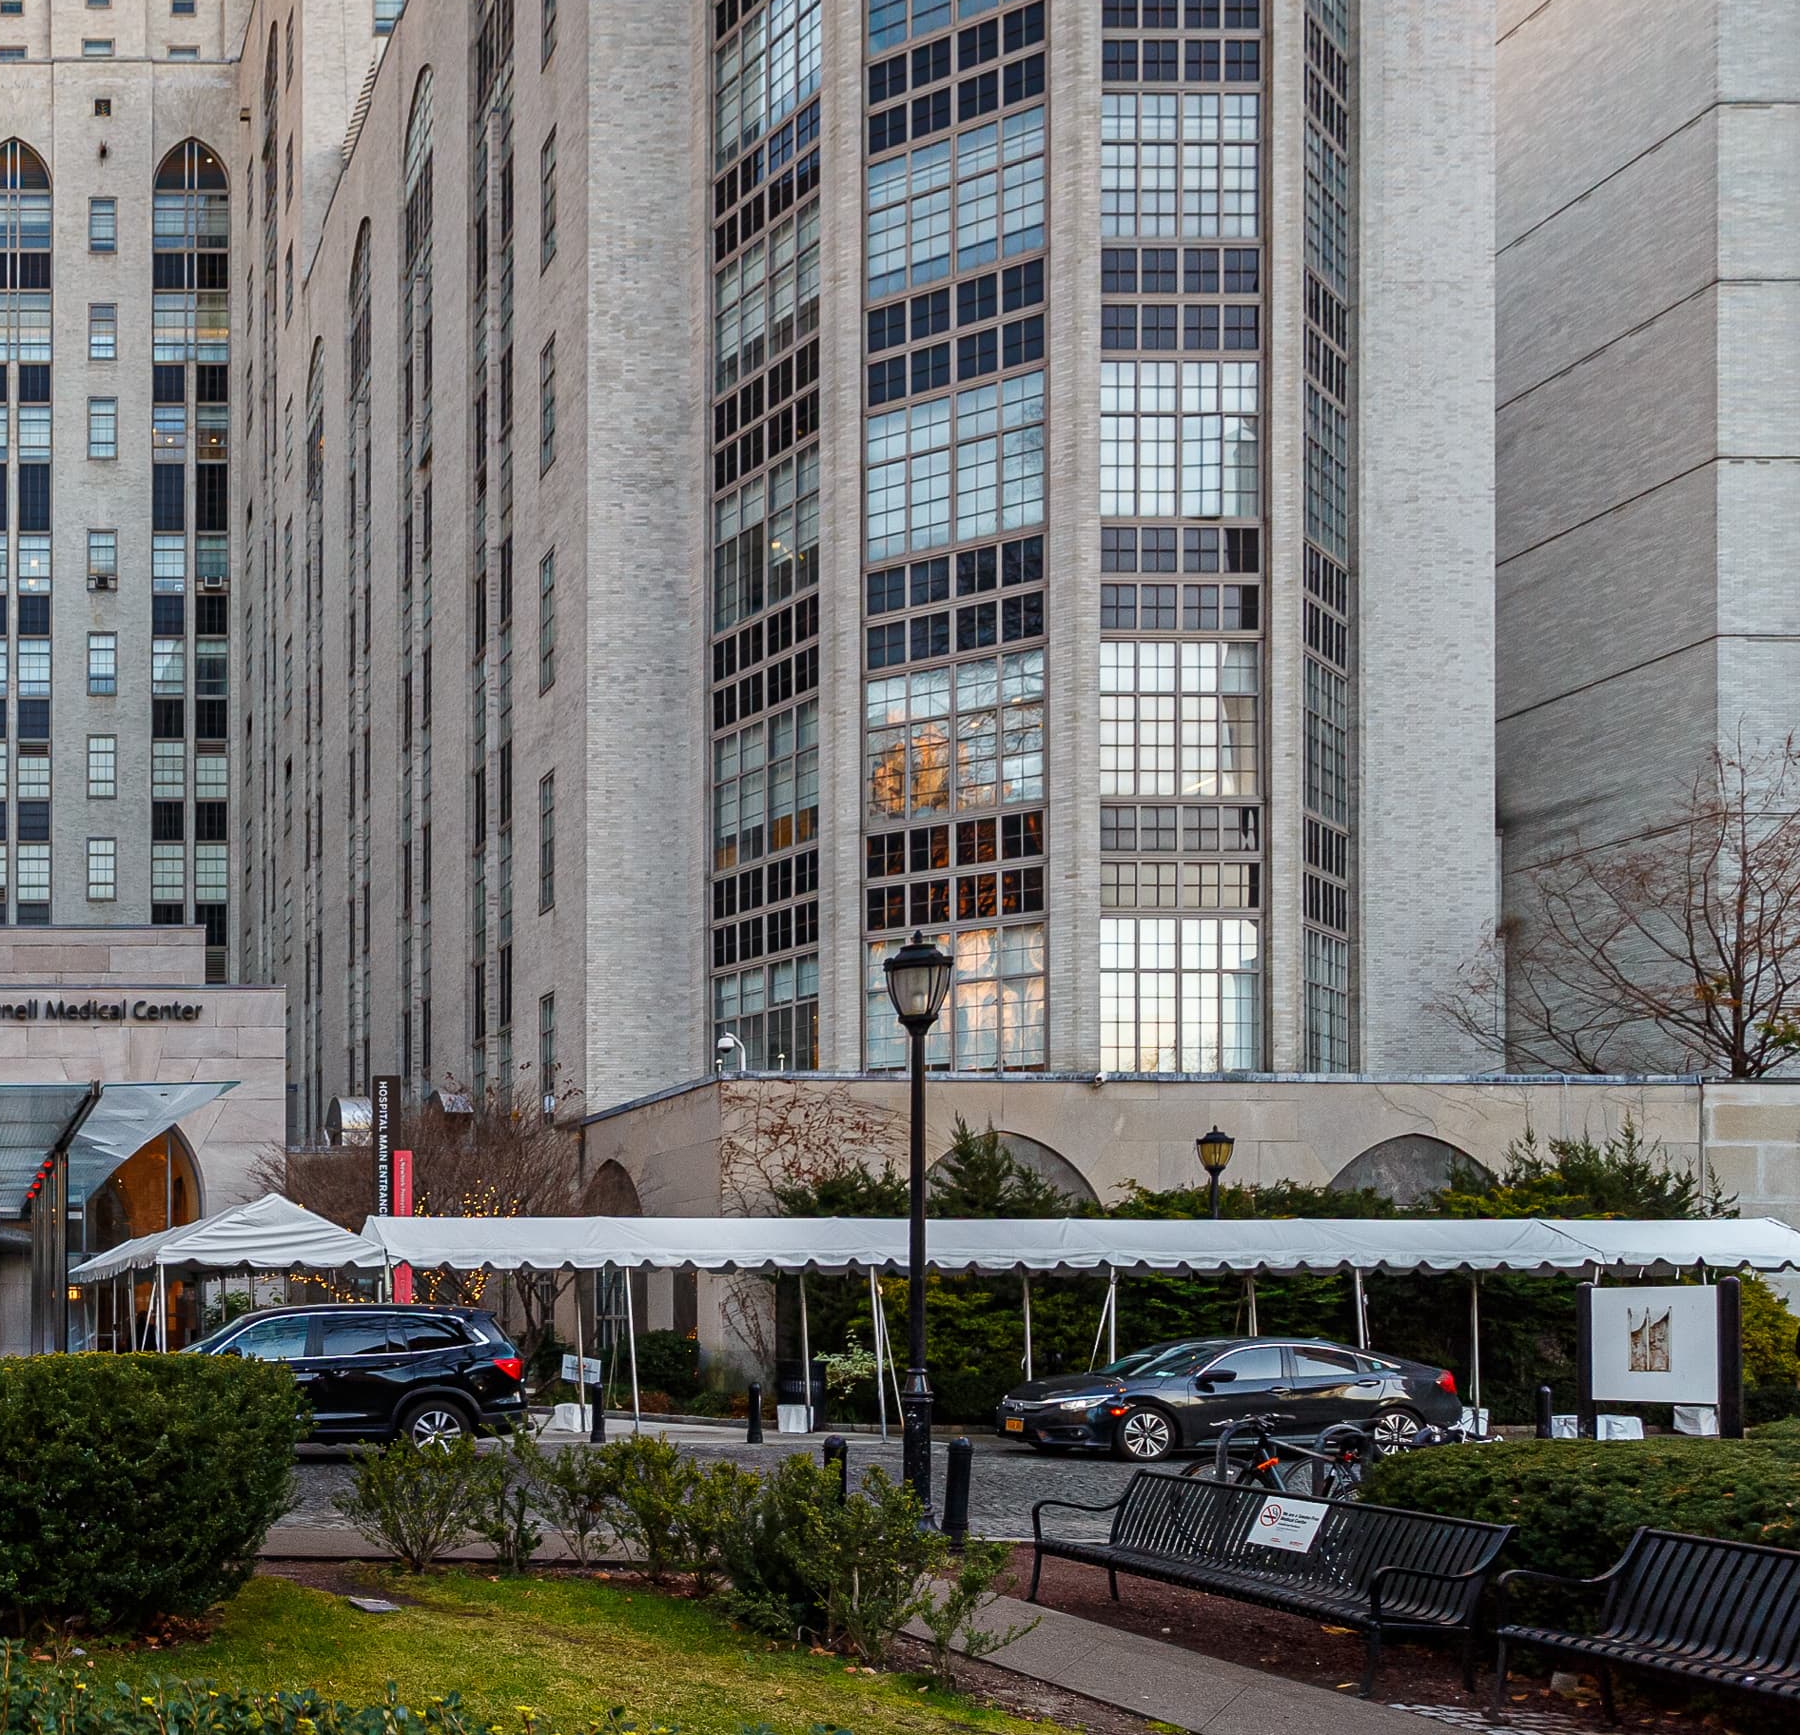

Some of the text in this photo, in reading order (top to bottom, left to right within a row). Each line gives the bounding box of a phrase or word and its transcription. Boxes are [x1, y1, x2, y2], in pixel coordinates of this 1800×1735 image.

[45, 999, 127, 1021] Medical
[133, 1000, 203, 1021] Center
[379, 1081, 388, 1132] HOSPITAL
[379, 1135, 388, 1161] MAIN
